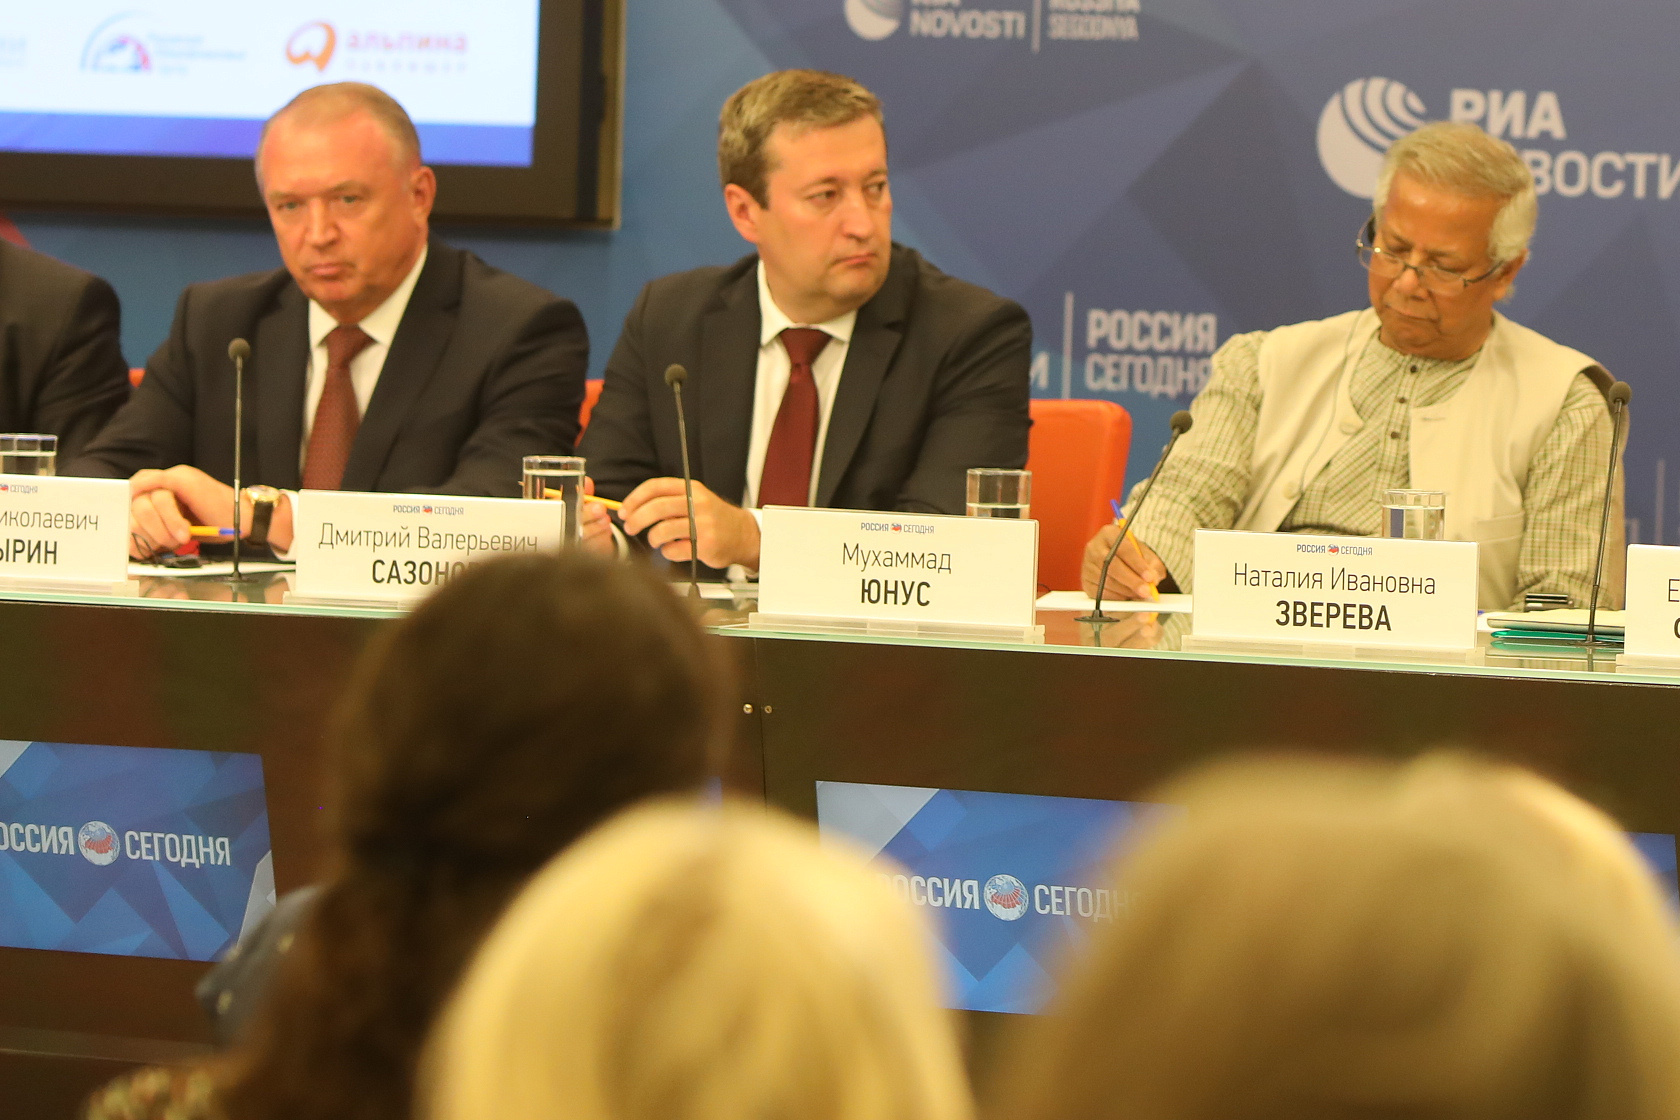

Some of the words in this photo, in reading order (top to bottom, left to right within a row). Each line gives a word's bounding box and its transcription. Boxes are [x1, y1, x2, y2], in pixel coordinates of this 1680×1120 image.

[909, 9, 1027, 39] NOVOSTI
[1450, 88, 1567, 140] РИА
[1086, 308, 1217, 352] РОССИЯ
[1085, 354, 1213, 398] СЕГОДНЯ
[393, 504, 421, 514] РОССИЯ
[434, 506, 464, 516] СЕГОДНЯ
[318, 522, 411, 553] Дмитрий
[418, 526, 538, 556] Валерьевич
[860, 522, 889, 532] РОССИЯ
[903, 524, 935, 535] СЕГОДНЯ
[842, 542, 952, 575] Мухаммад
[1296, 543, 1326, 554] РОССИЯ
[1340, 545, 1373, 557] СЕГОДНЯ
[860, 578, 931, 607] ЮНУС
[1233, 562, 1323, 590] Наталия
[1330, 567, 1436, 595] Ивановна
[1275, 600, 1392, 632] ЗВЕРЕВА
[125, 830, 231, 869] СЕГОДНЯ
[1034, 884, 1133, 923] СЕГОДН
